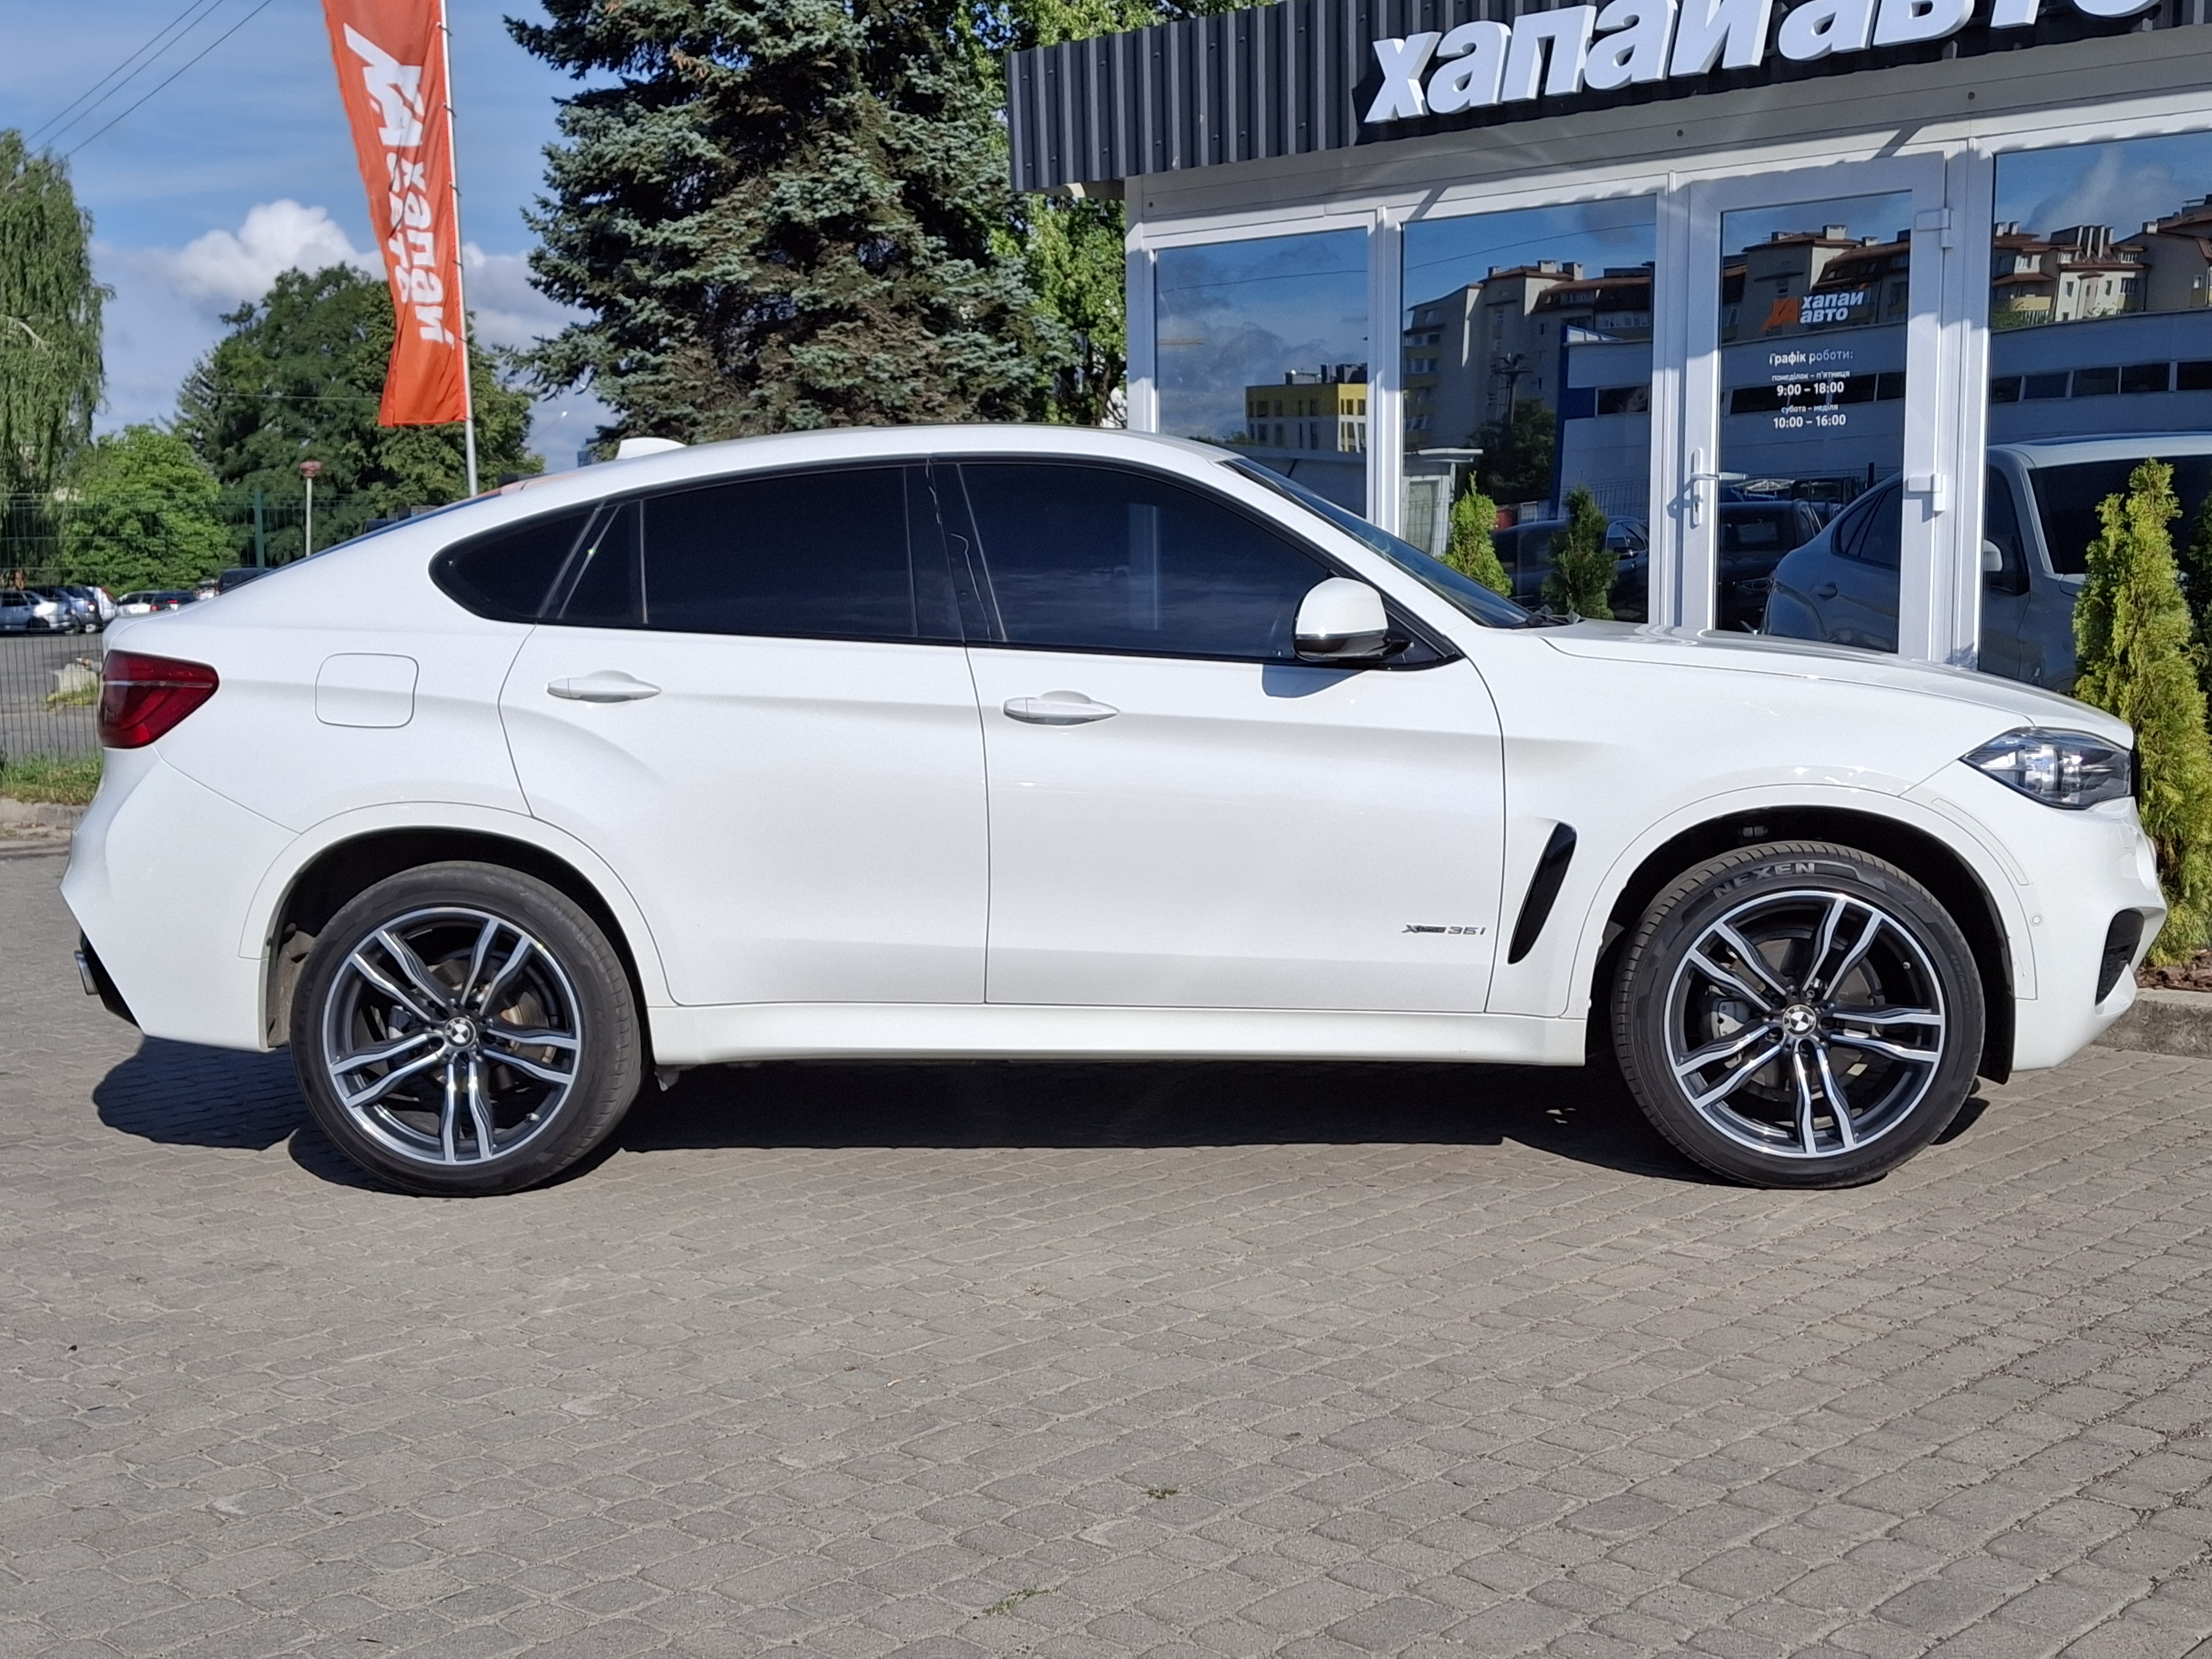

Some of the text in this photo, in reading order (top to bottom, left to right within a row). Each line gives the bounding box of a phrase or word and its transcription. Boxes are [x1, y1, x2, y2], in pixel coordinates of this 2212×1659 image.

[1799, 307, 1849, 324] авто
[1769, 349, 1854, 367] Графік роботи:
[1776, 383, 1802, 397] 9:00
[1814, 381, 1844, 395] 18:00
[1780, 404, 1806, 415] субота
[1814, 402, 1838, 412] неділя
[1773, 416, 1804, 429] 10:00
[1815, 414, 1847, 427] 16:00
[1713, 863, 1815, 899] NEXEN
